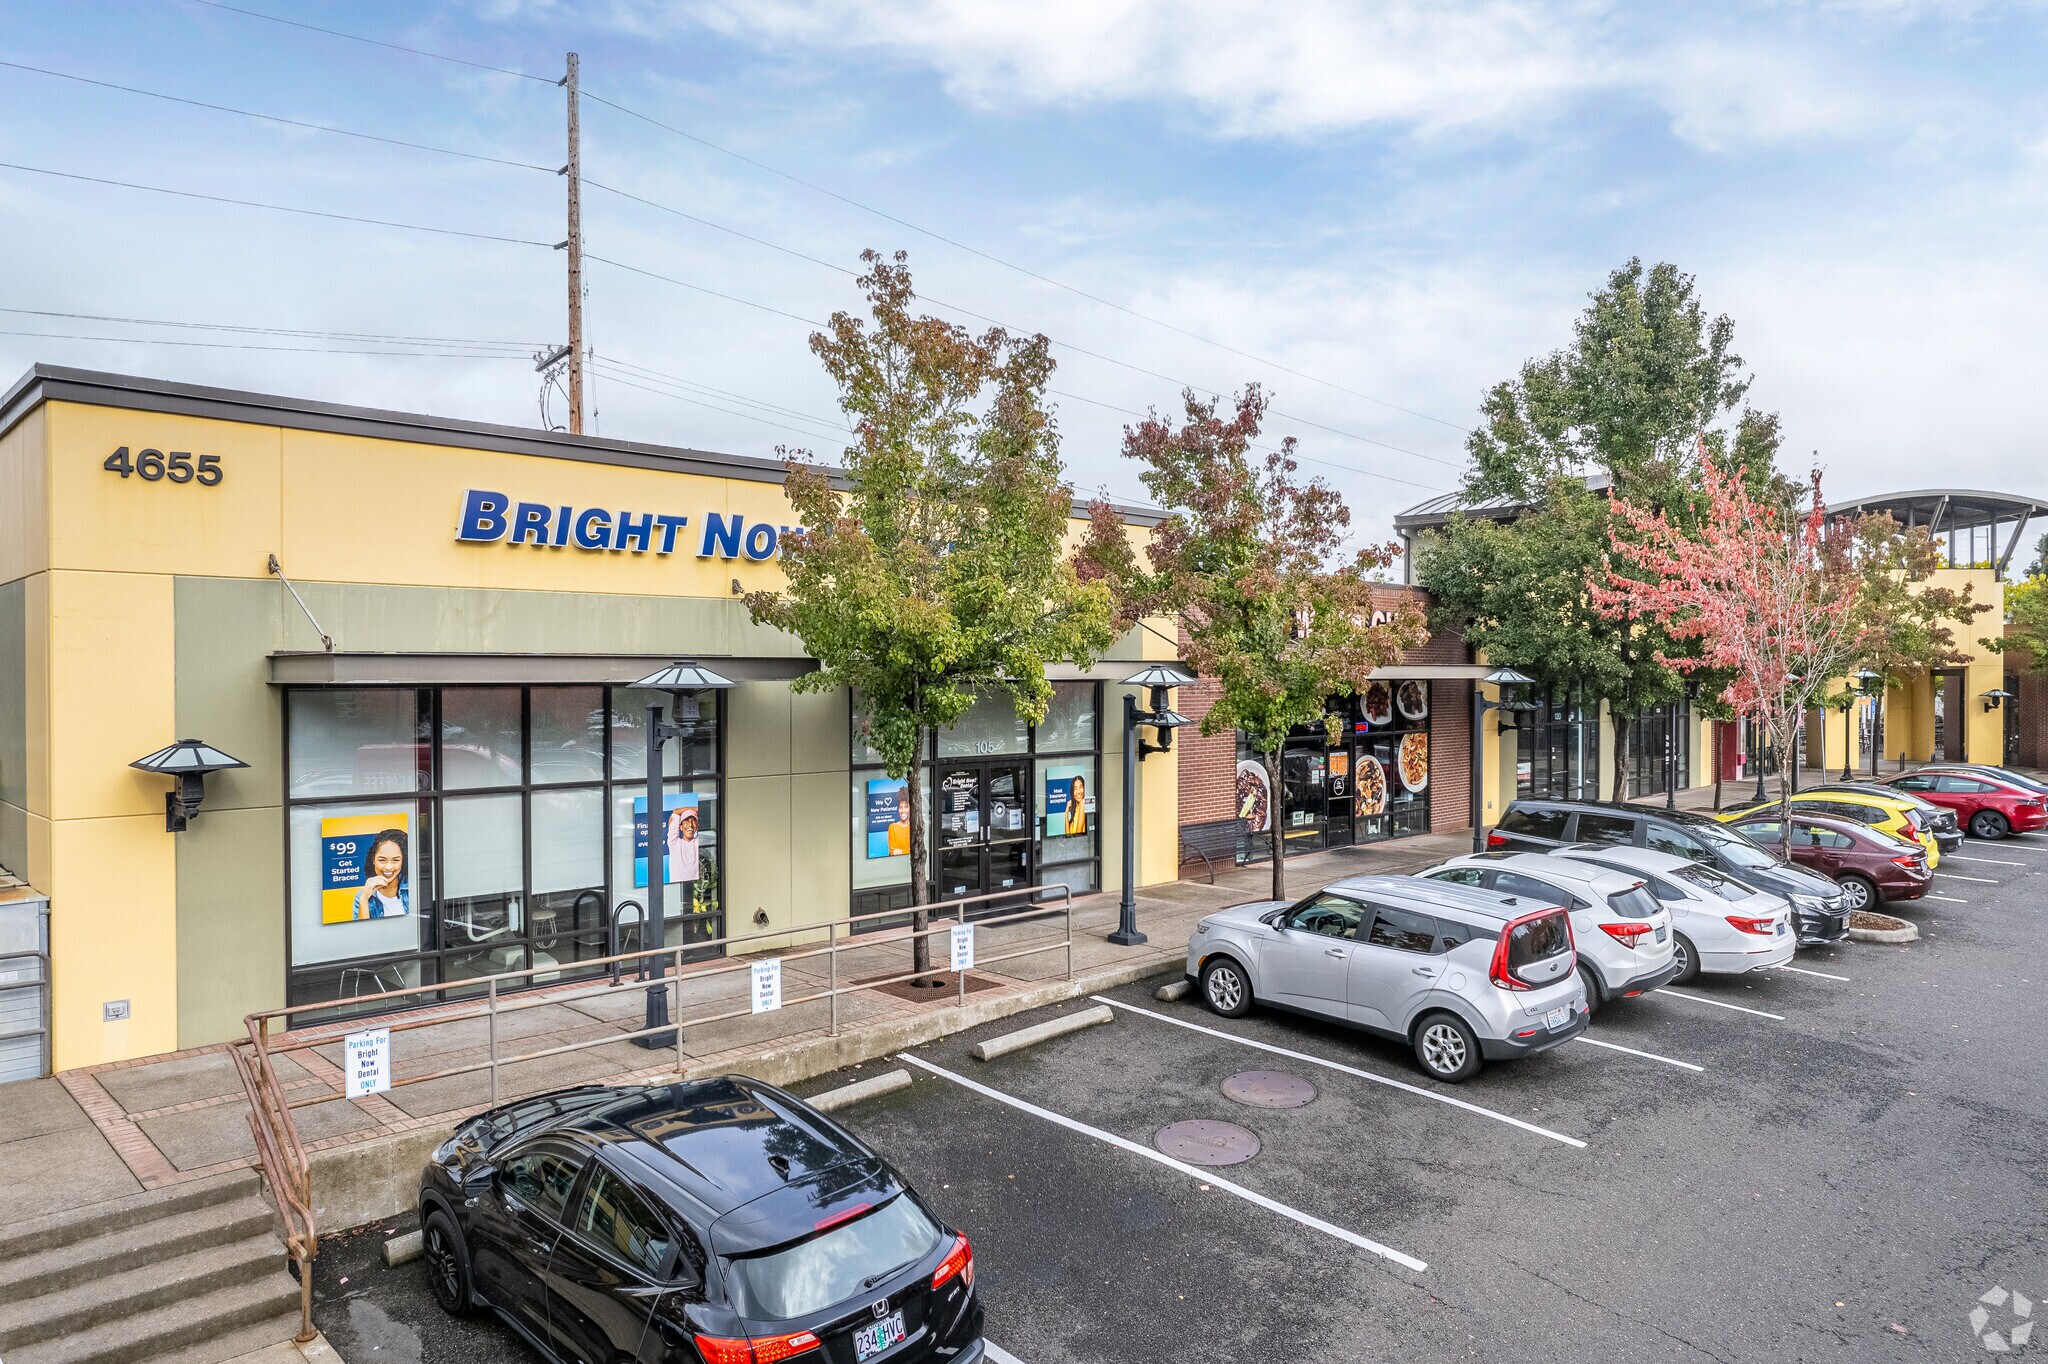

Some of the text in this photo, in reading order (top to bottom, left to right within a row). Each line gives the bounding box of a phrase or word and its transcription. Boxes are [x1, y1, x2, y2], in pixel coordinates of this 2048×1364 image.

[104, 446, 223, 486] 4655
[455, 489, 688, 554] BRIGHT
[975, 741, 994, 754] 105
[330, 842, 356, 855] $99
[331, 866, 359, 875] Started
[348, 1036, 386, 1049] Parking For
[357, 1049, 378, 1058] Bright
[361, 1060, 375, 1068] Now
[358, 1068, 378, 1078] Dental
[360, 1079, 376, 1089] ONLY
[857, 1330, 877, 1354] 234
[882, 1317, 903, 1341] HVC
